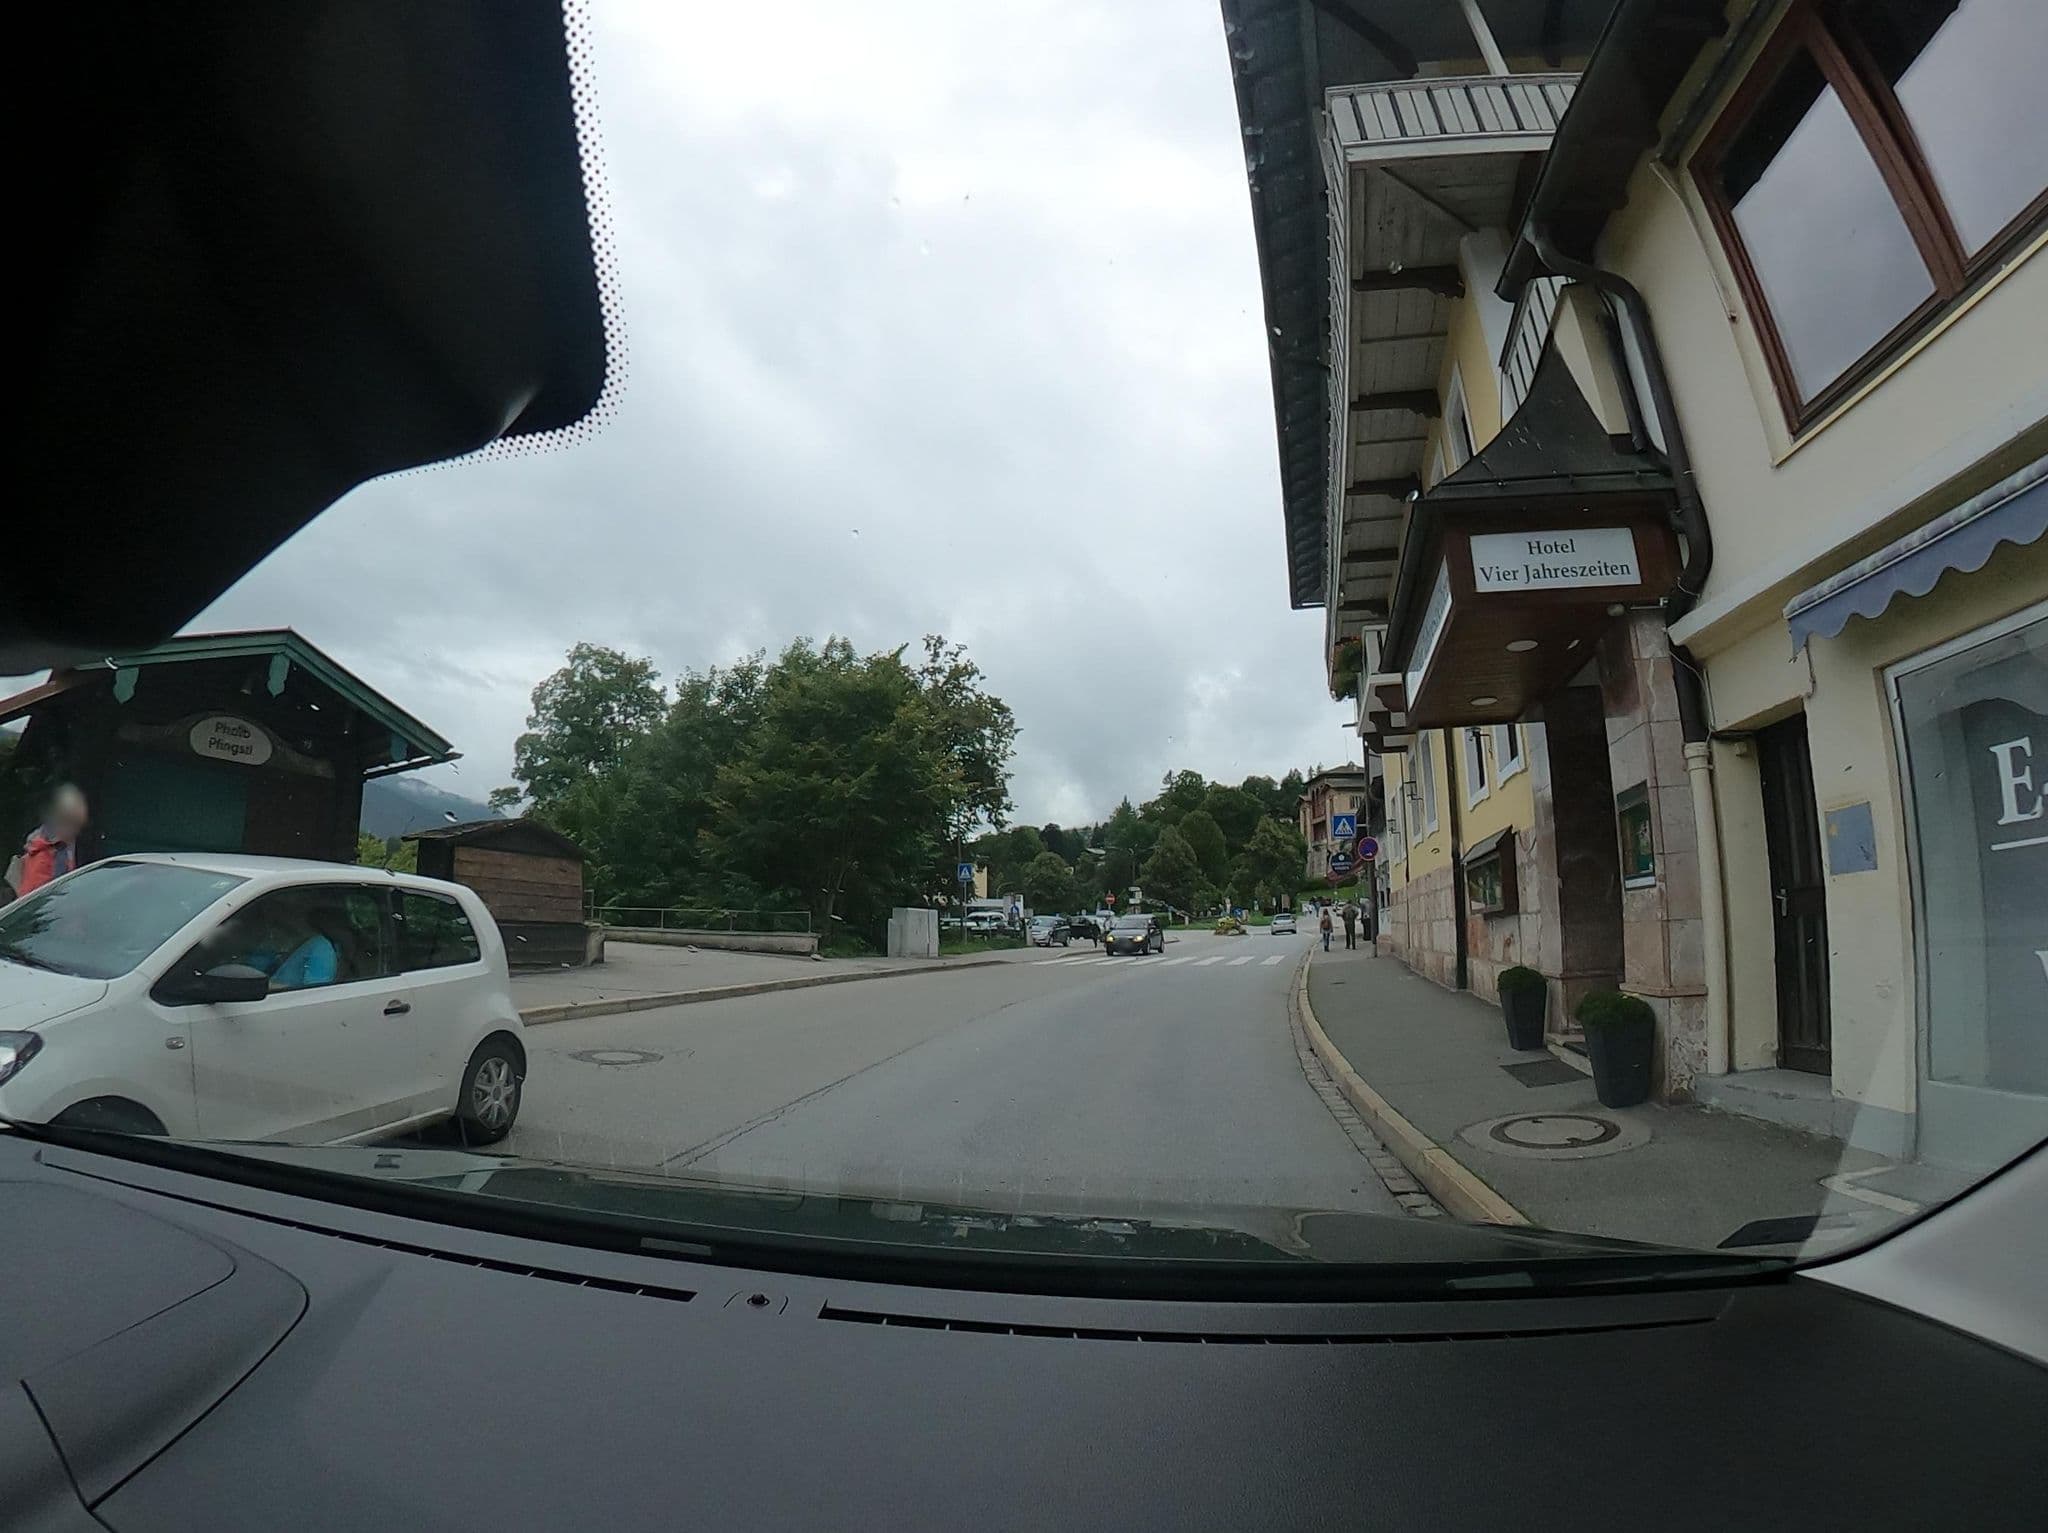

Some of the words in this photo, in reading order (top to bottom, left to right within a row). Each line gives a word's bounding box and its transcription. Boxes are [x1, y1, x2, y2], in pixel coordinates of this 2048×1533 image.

[1527, 539, 1576, 555] Hotel
[1480, 565, 1519, 583] Vier
[1524, 560, 1631, 584] Jahreszeiten
